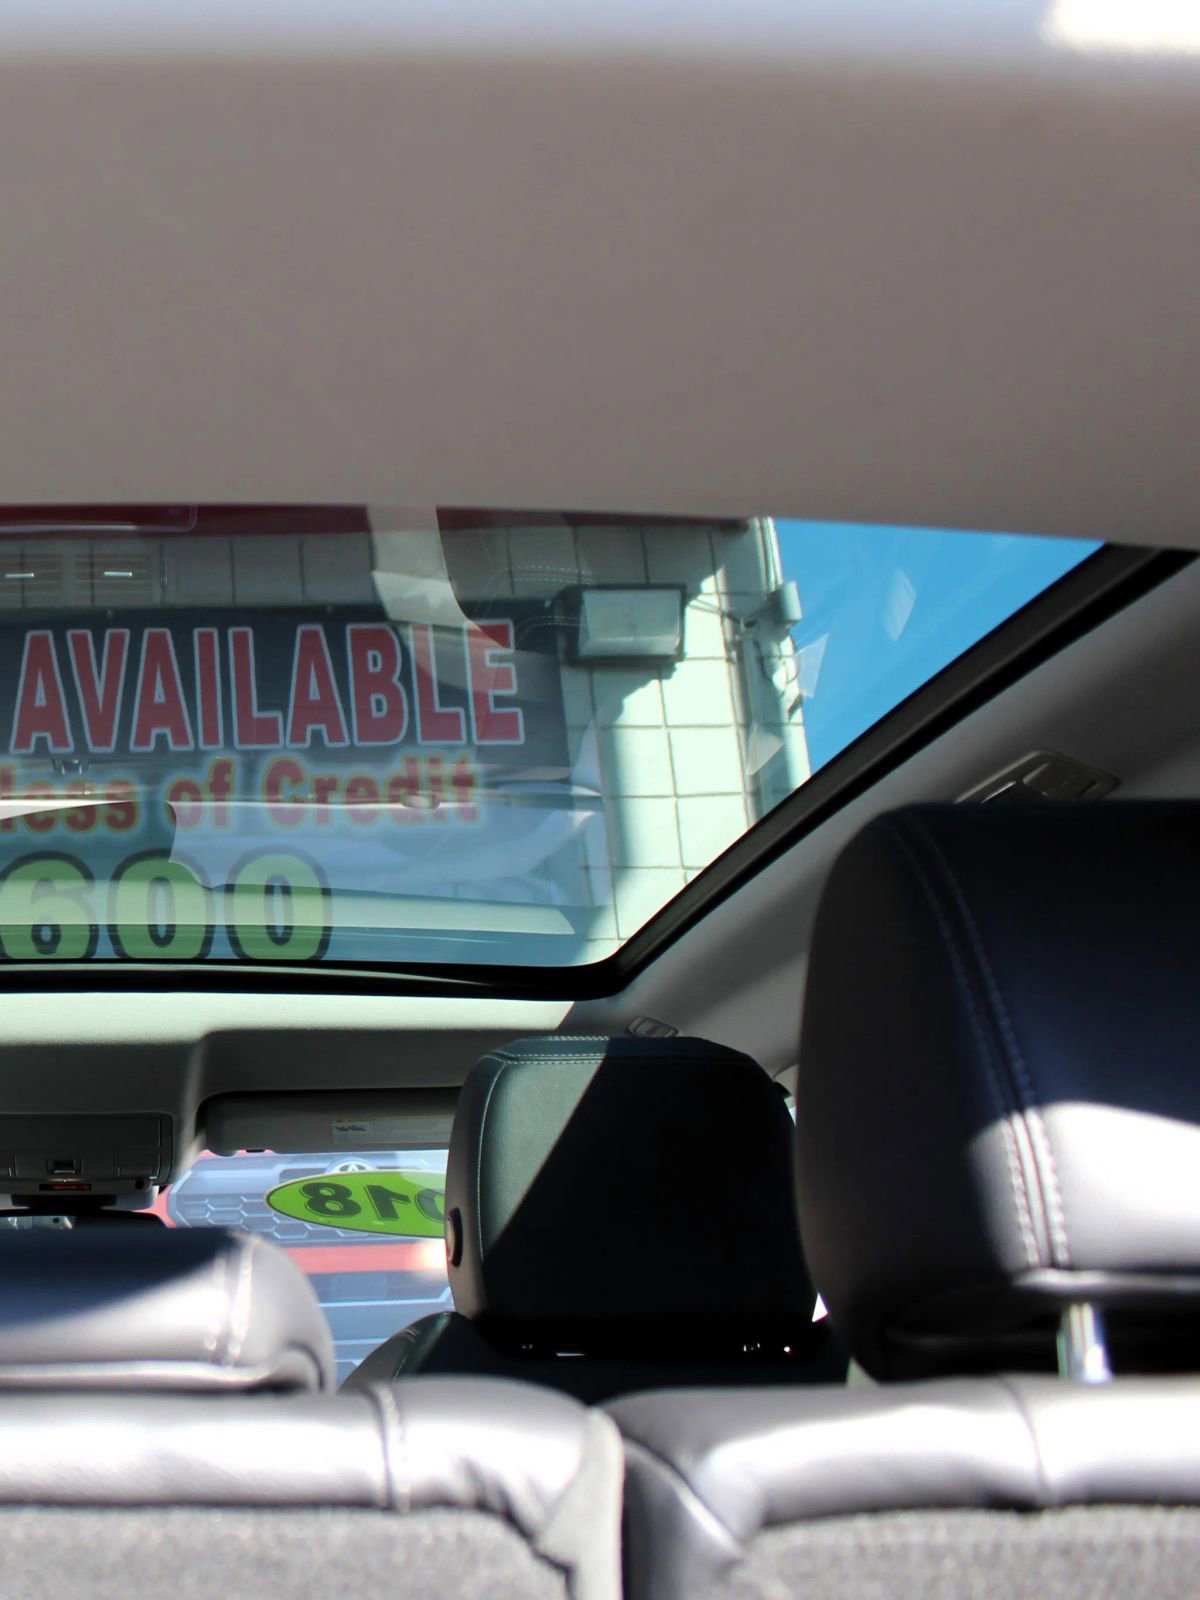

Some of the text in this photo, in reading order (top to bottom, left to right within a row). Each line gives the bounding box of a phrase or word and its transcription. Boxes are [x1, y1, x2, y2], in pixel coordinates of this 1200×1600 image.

[9, 618, 525, 755] AVAILABLE
[165, 758, 236, 831] of
[262, 756, 480, 829] Credit
